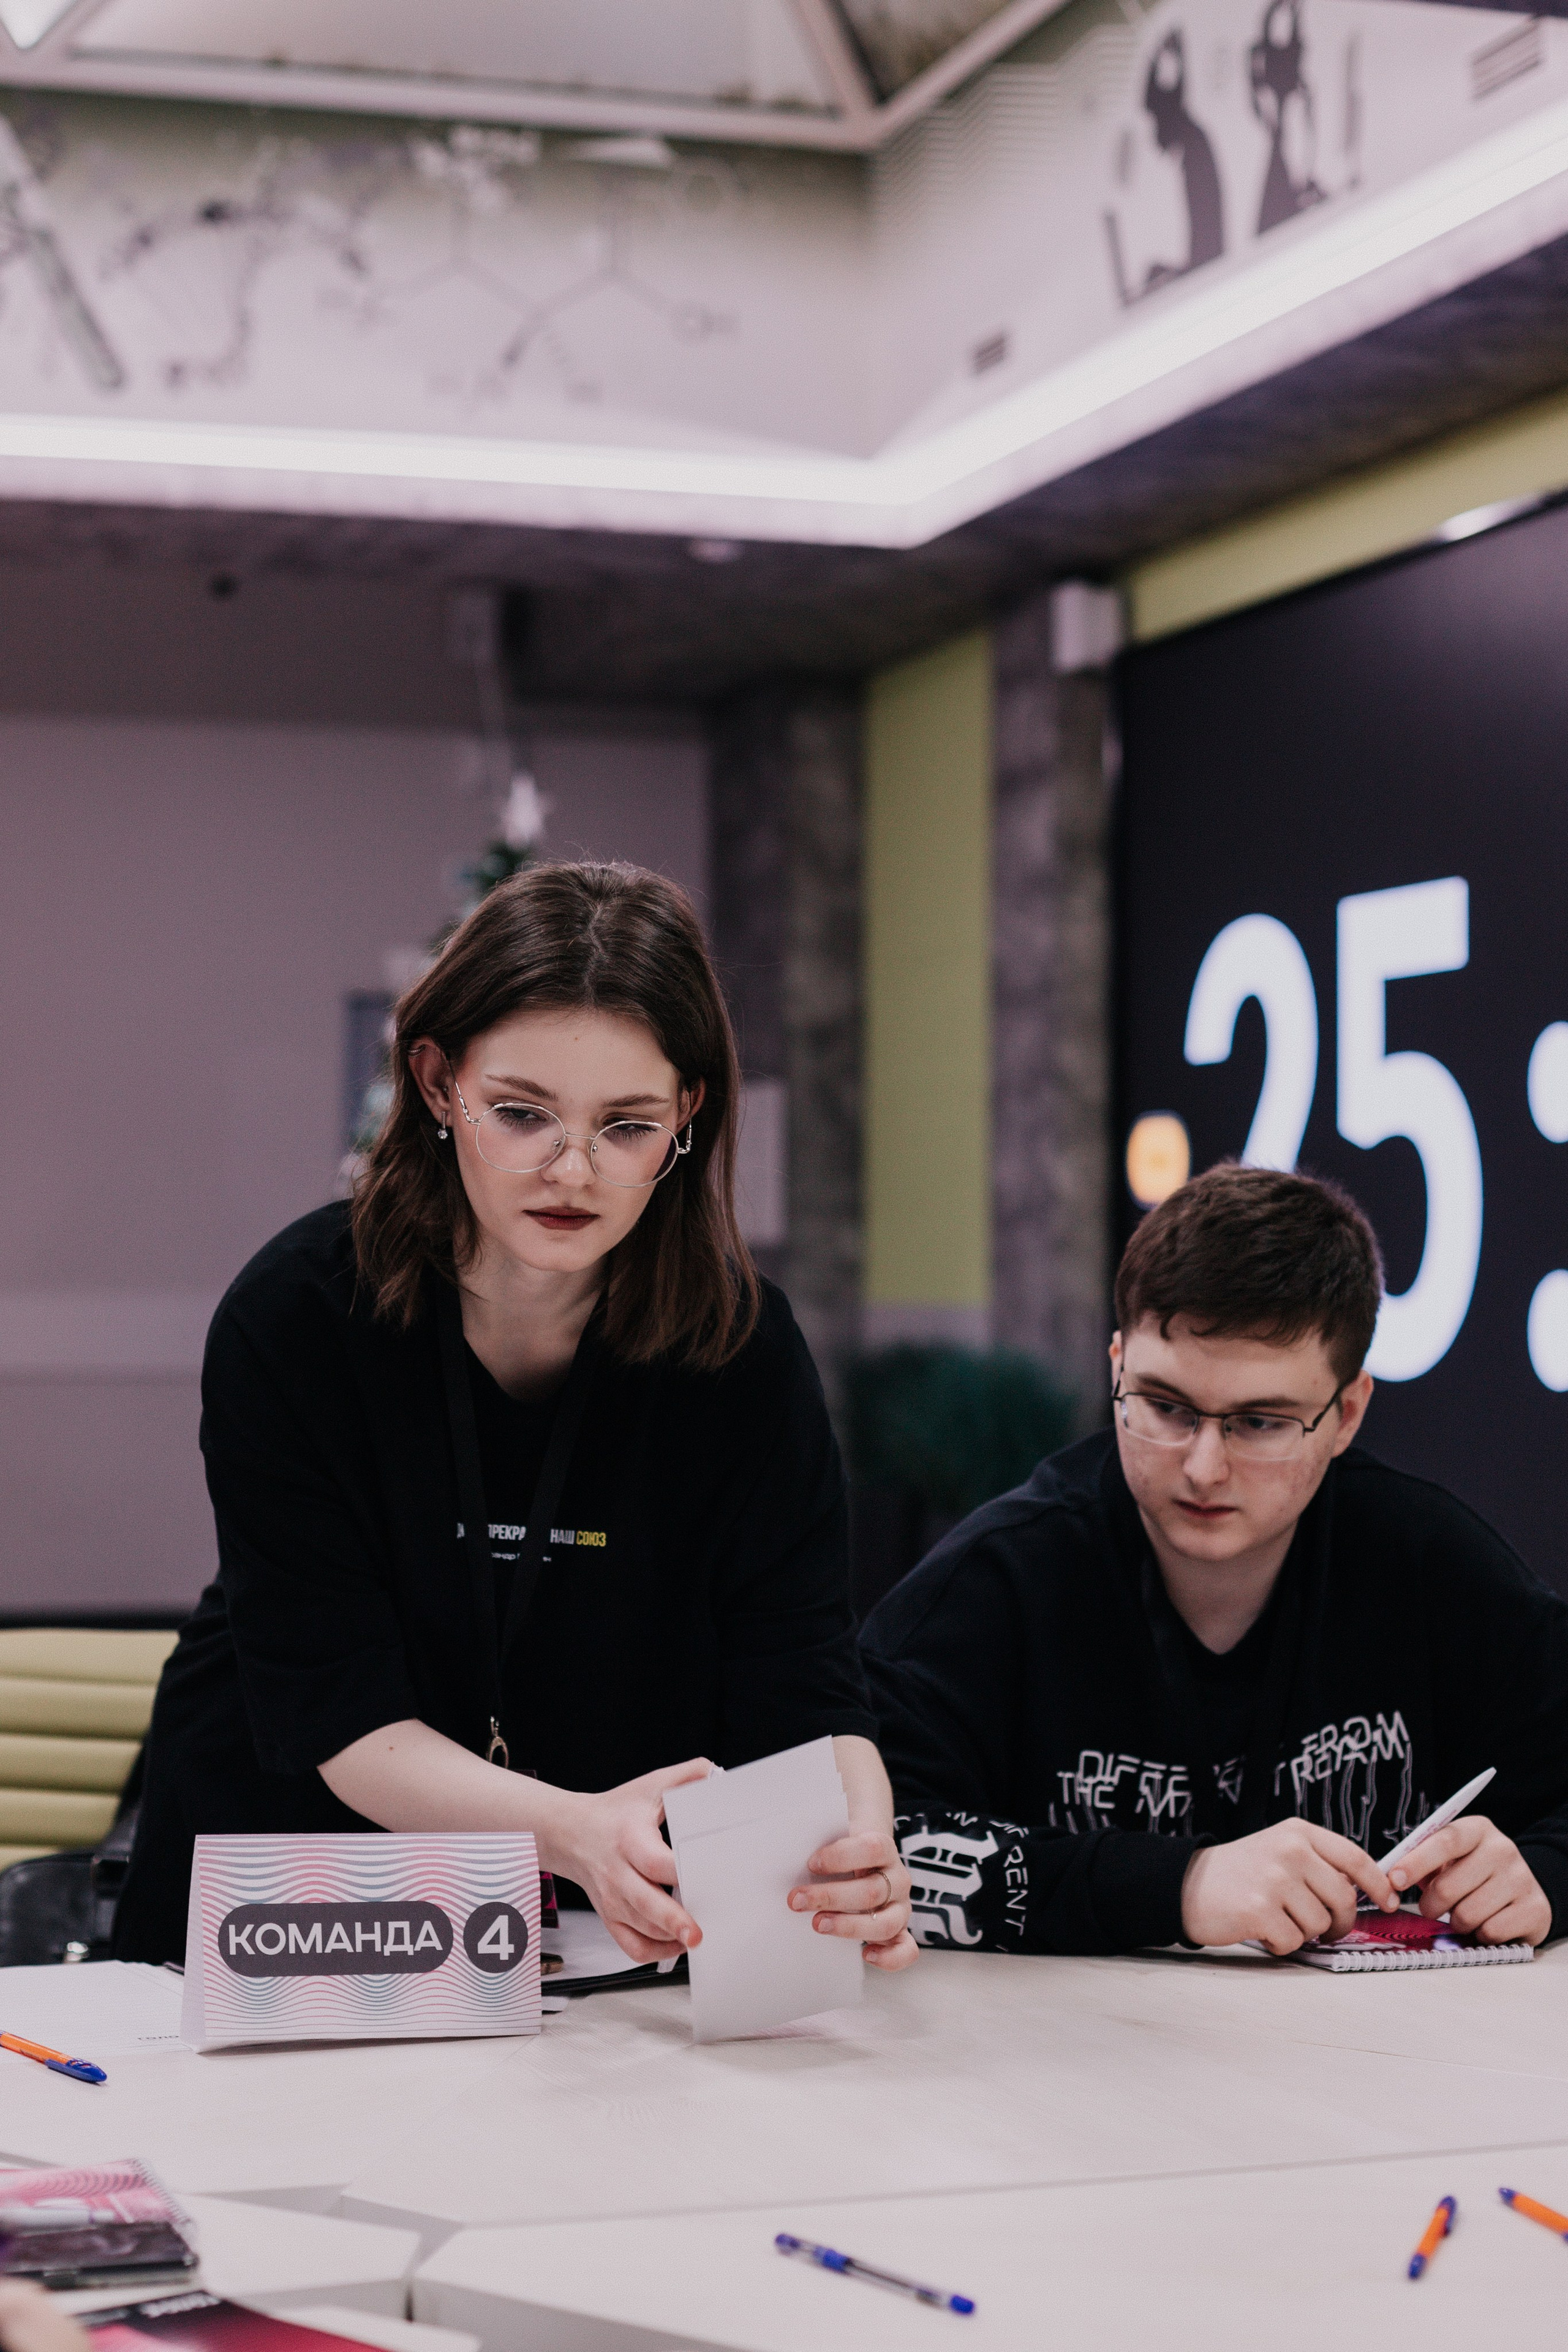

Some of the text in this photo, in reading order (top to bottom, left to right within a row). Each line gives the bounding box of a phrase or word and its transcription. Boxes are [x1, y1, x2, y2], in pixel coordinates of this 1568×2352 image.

[550, 1529, 575, 1545] НАШ
[576, 1531, 606, 1547] СОЮЗ
[228, 1914, 515, 1961] КОМАНДА 4
